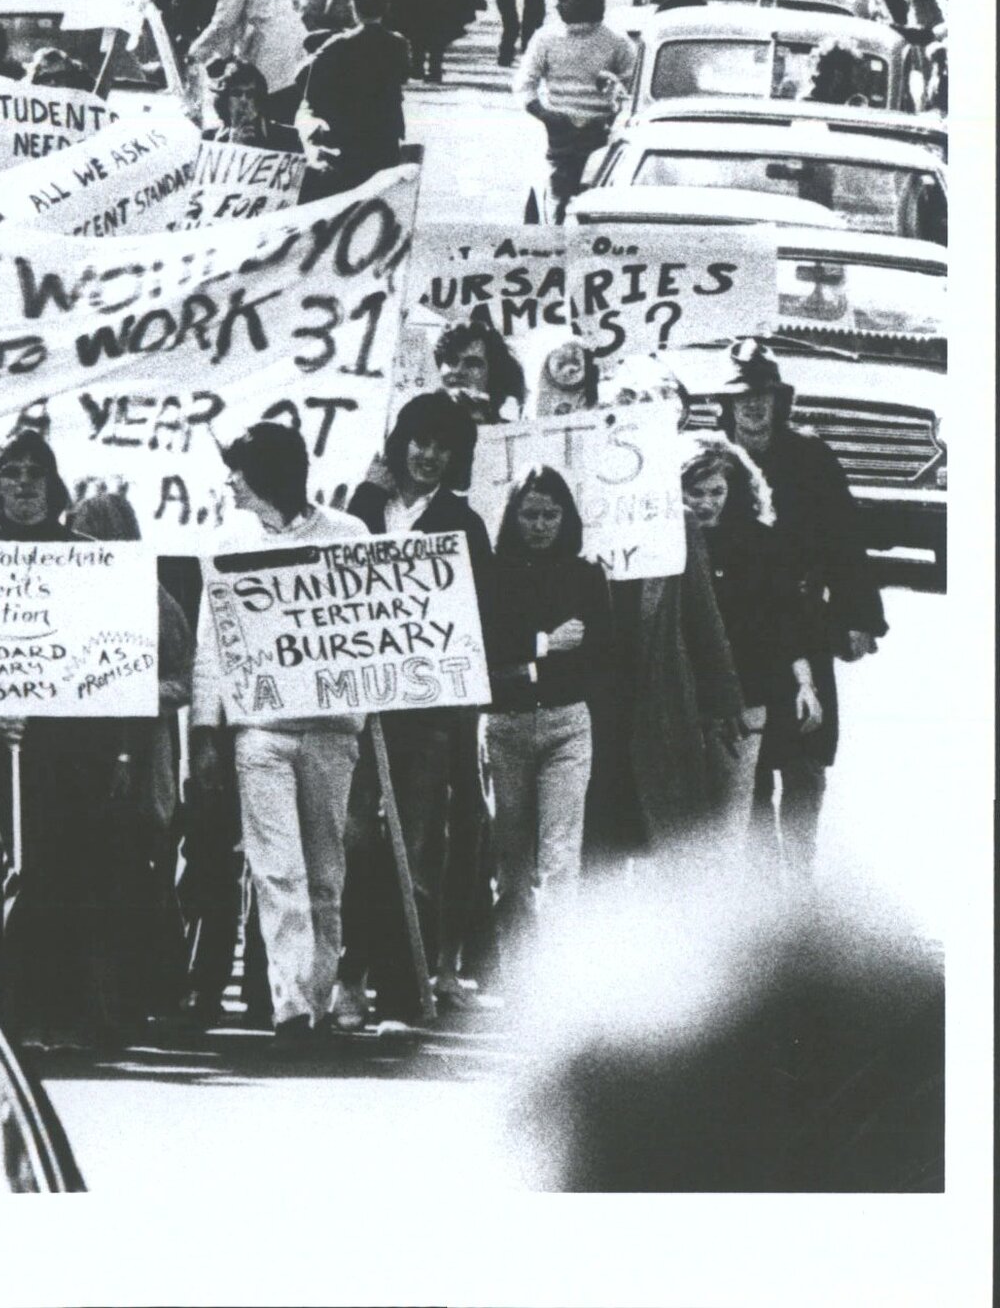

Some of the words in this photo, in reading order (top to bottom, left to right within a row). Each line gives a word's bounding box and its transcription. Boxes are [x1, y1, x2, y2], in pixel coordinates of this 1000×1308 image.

[28, 179, 71, 215] ALL
[72, 158, 108, 188] WE
[110, 138, 150, 170] ASK
[133, 160, 198, 215] STANDAR
[197, 142, 307, 193] NIVERS
[419, 262, 738, 316] URSARIES
[75, 288, 284, 368] WORK
[292, 291, 388, 378] 31
[233, 556, 455, 613] STANDARD
[283, 595, 431, 628] TERTIARY
[98, 647, 128, 666] AS
[276, 621, 455, 668] BURSARY
[252, 674, 285, 712] A
[315, 656, 472, 710] MUST
